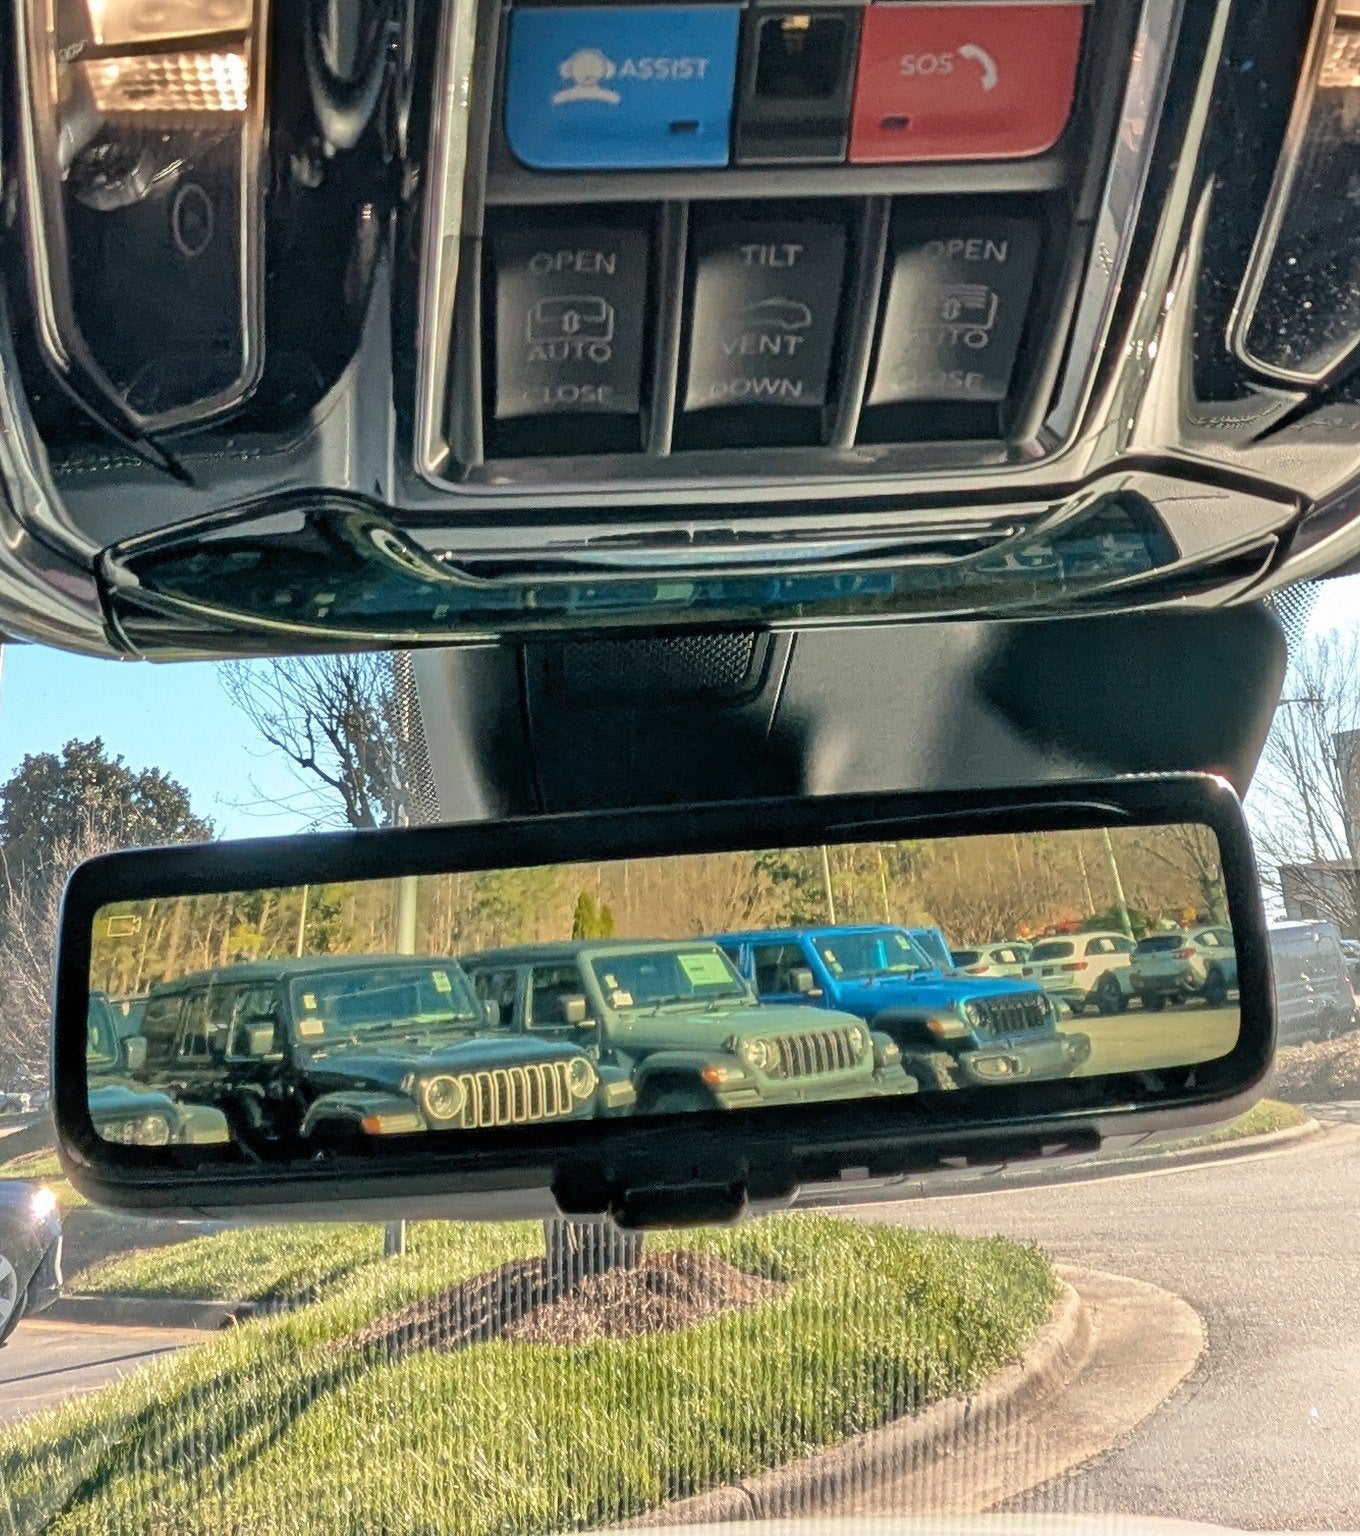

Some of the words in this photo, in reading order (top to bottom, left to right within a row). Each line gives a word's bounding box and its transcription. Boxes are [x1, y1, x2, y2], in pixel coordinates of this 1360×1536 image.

[619, 57, 710, 80] ASSIST
[900, 53, 954, 77] SOS
[529, 249, 617, 275] OPEN
[741, 244, 804, 267] TILT
[925, 238, 1009, 264] OPEN
[722, 333, 807, 356] VENT
[910, 328, 989, 349] UTO
[527, 340, 613, 363] AUTO
[523, 384, 612, 404] LOSE
[708, 378, 803, 398] DOWN
